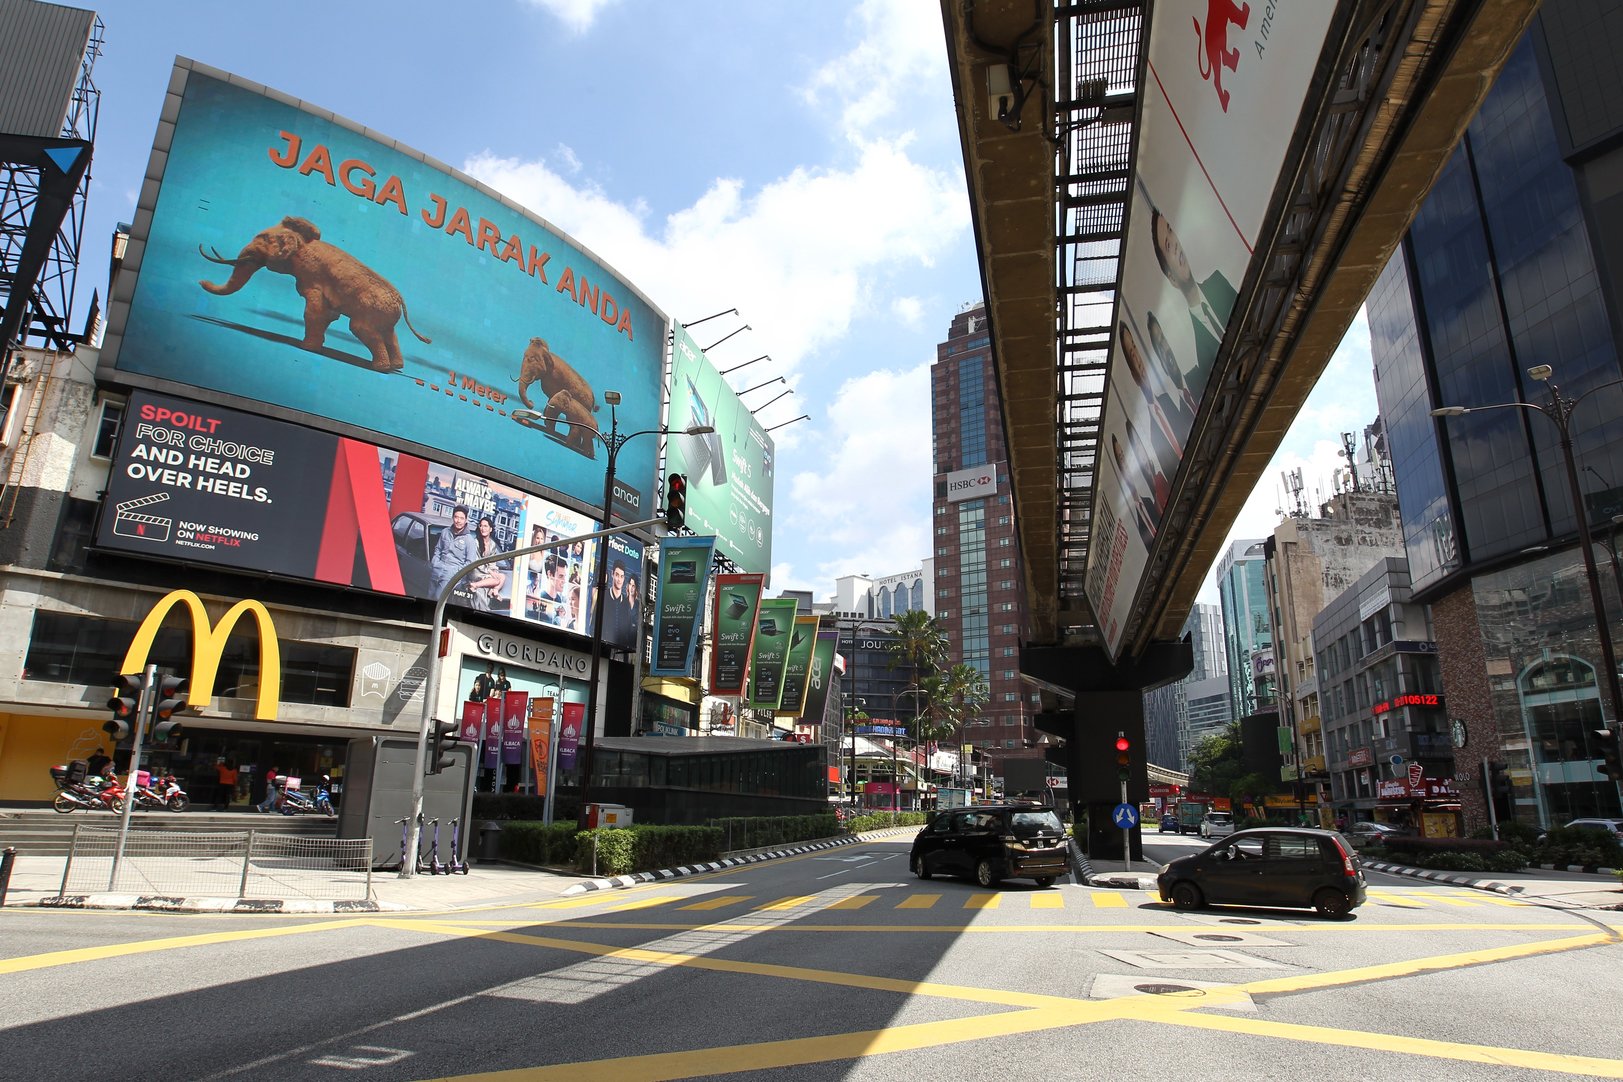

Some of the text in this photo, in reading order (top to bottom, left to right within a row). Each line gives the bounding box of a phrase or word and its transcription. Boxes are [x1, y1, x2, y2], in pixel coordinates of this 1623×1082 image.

[1255, 41, 1265, 60] A
[268, 130, 634, 342] JAGA JARAK ANDA
[448, 370, 508, 406] 1 Meter
[140, 404, 222, 434] SPOILT
[136, 423, 275, 466] FOR CHOICE
[131, 444, 251, 479] AND HEAD
[127, 463, 273, 504] OVER HEELS.
[454, 478, 493, 500] ALWAYS
[950, 478, 976, 491] HSBC
[463, 494, 497, 514] MAYBE
[177, 529, 241, 547] ON NETFLIX
[179, 521, 259, 541] NOW SHOWING
[175, 539, 216, 550] NETFLIX.COM
[624, 545, 640, 559] Date
[880, 572, 923, 585] HOTEL ISTANA
[453, 589, 466, 597] MAY
[665, 604, 692, 614] Swift 5
[721, 632, 745, 642] Swift 5
[477, 633, 588, 673] GIORDANO
[758, 652, 775, 661] Swift
[786, 664, 799, 672] wift
